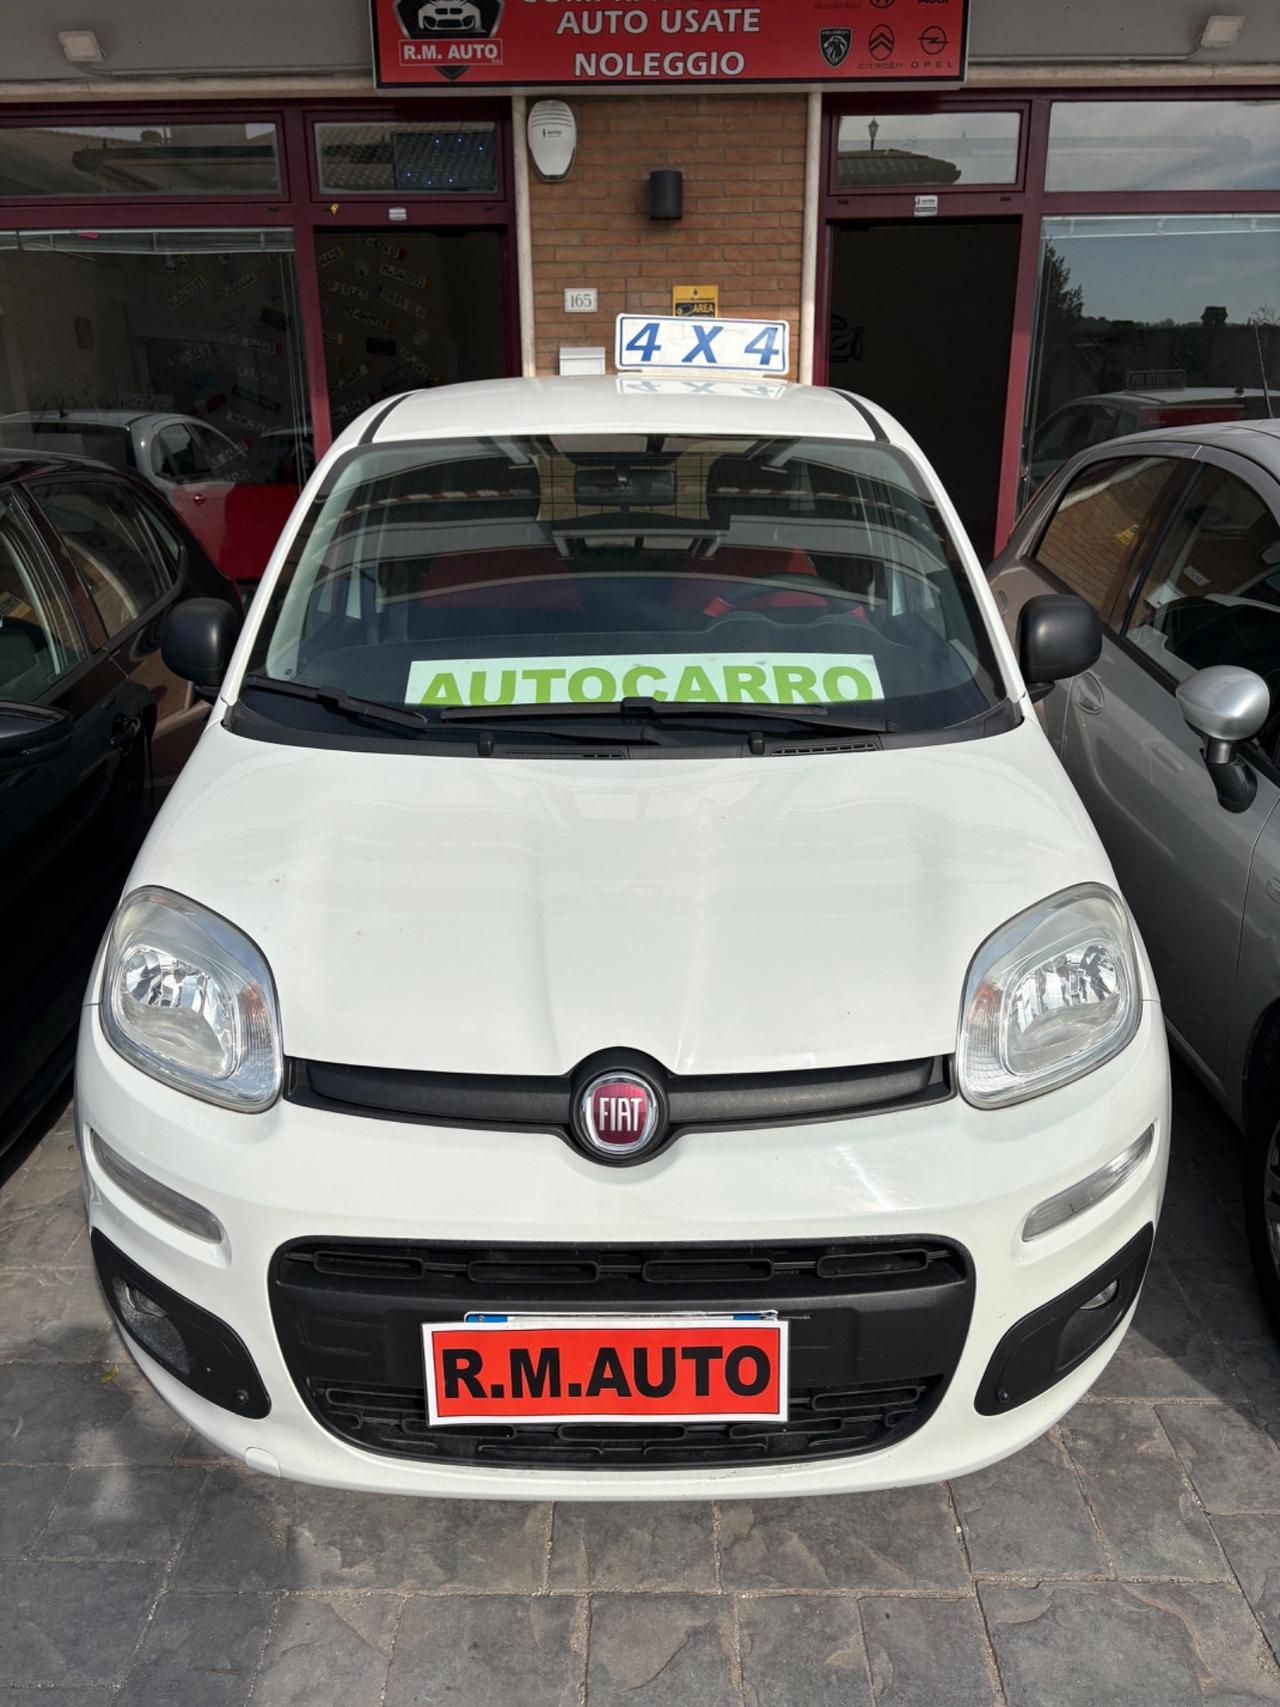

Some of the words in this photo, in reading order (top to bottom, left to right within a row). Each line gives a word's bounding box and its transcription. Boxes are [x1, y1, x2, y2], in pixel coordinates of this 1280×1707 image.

[556, 10, 649, 34] AUTO
[660, 8, 761, 33] USATE
[403, 45, 442, 60] R.M.
[448, 44, 498, 60] AUTO
[574, 51, 745, 77] NOLEGGIO
[570, 293, 592, 308] 165
[692, 303, 714, 313] AREA
[625, 322, 662, 362] 4
[681, 325, 724, 364] X
[744, 327, 779, 366] 4
[418, 665, 873, 706] AUTOCARRO
[599, 1097, 643, 1131] FIAT
[441, 1345, 771, 1399] R.M.AUTO
